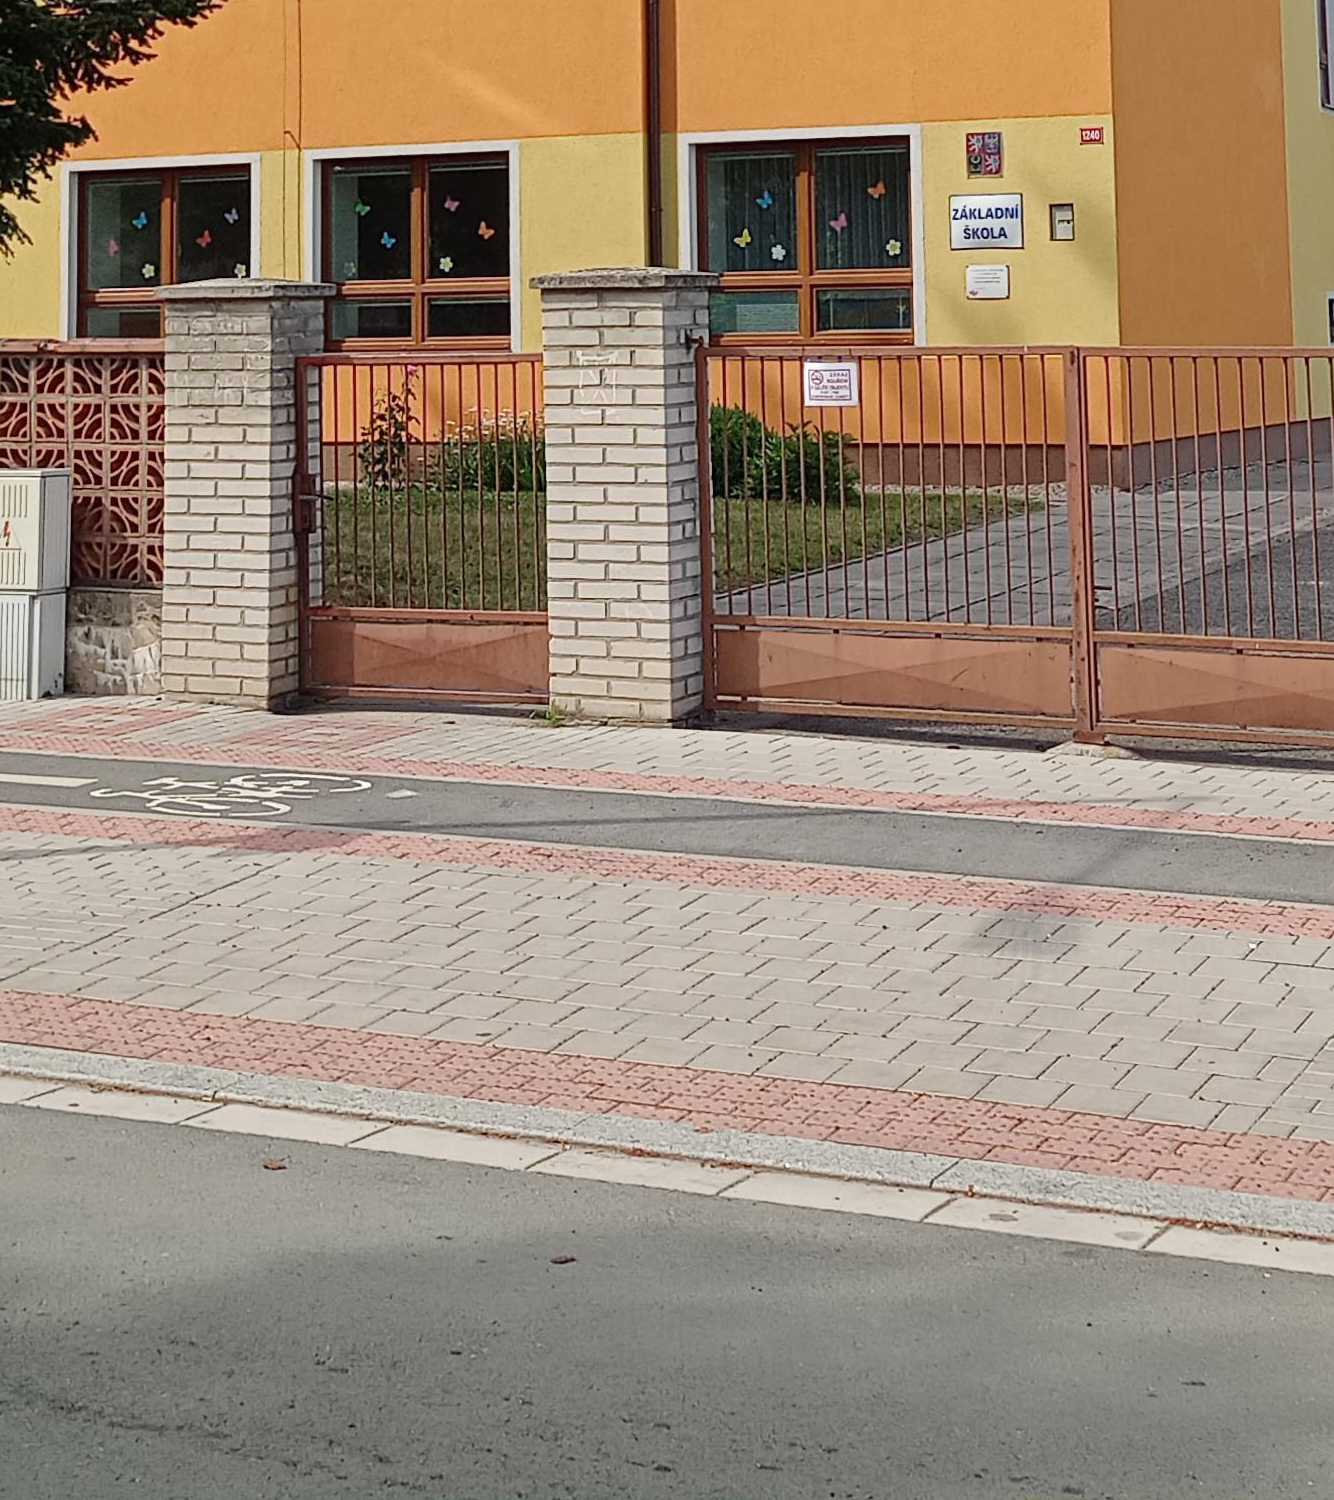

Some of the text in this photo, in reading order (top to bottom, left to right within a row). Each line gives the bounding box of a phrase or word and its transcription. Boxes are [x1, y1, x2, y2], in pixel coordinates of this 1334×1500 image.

[1082, 130, 1100, 141] 1240
[952, 204, 1019, 220] ZÁKLADNÍ
[963, 225, 1008, 240] ŠKOLA
